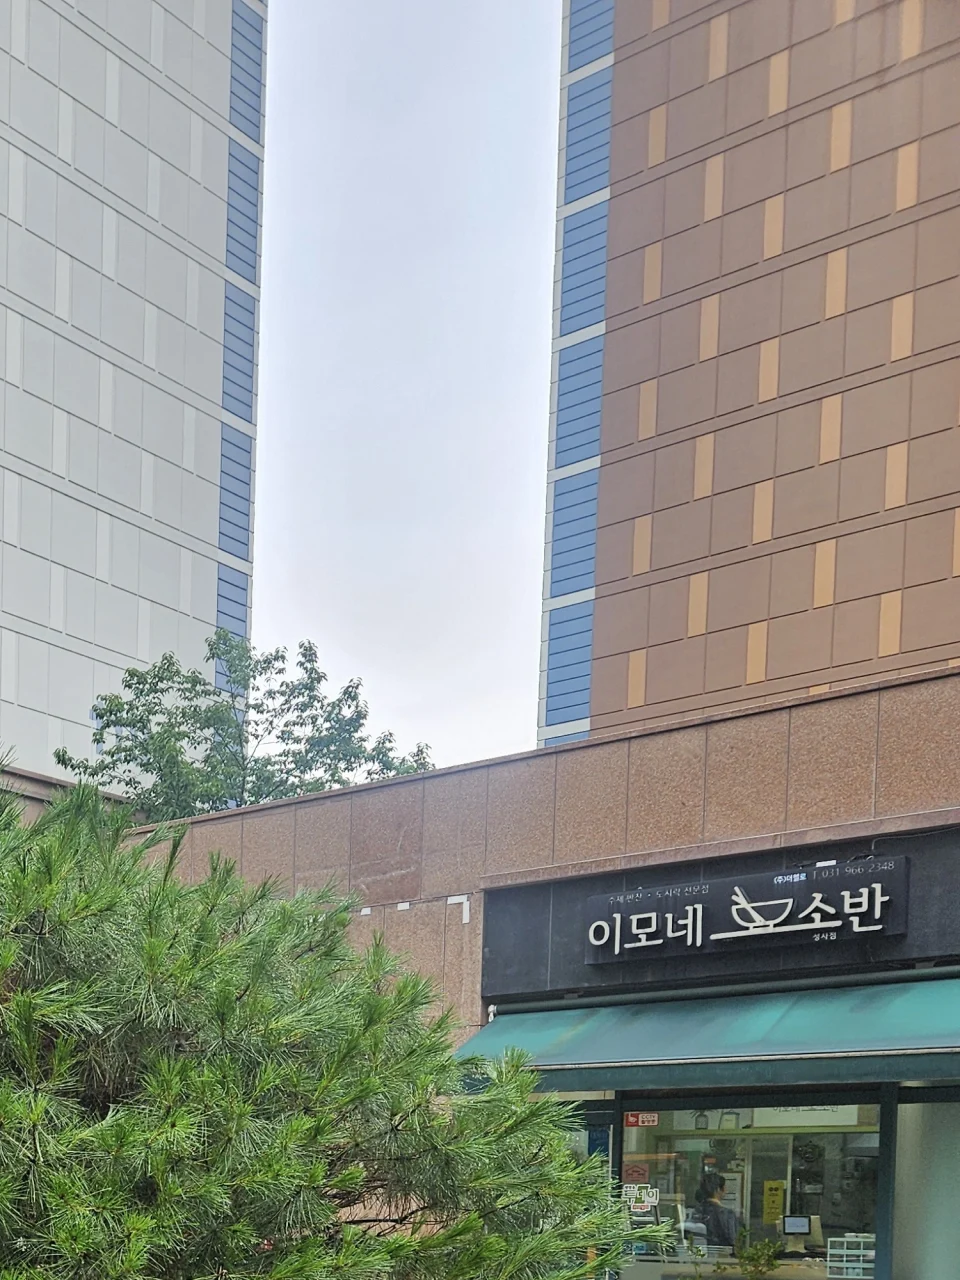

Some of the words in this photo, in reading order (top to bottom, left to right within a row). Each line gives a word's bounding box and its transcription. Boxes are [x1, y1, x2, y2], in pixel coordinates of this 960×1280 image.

[868, 861, 895, 873] 2348
[588, 903, 703, 955] 이모네
[798, 883, 889, 932] 소반
